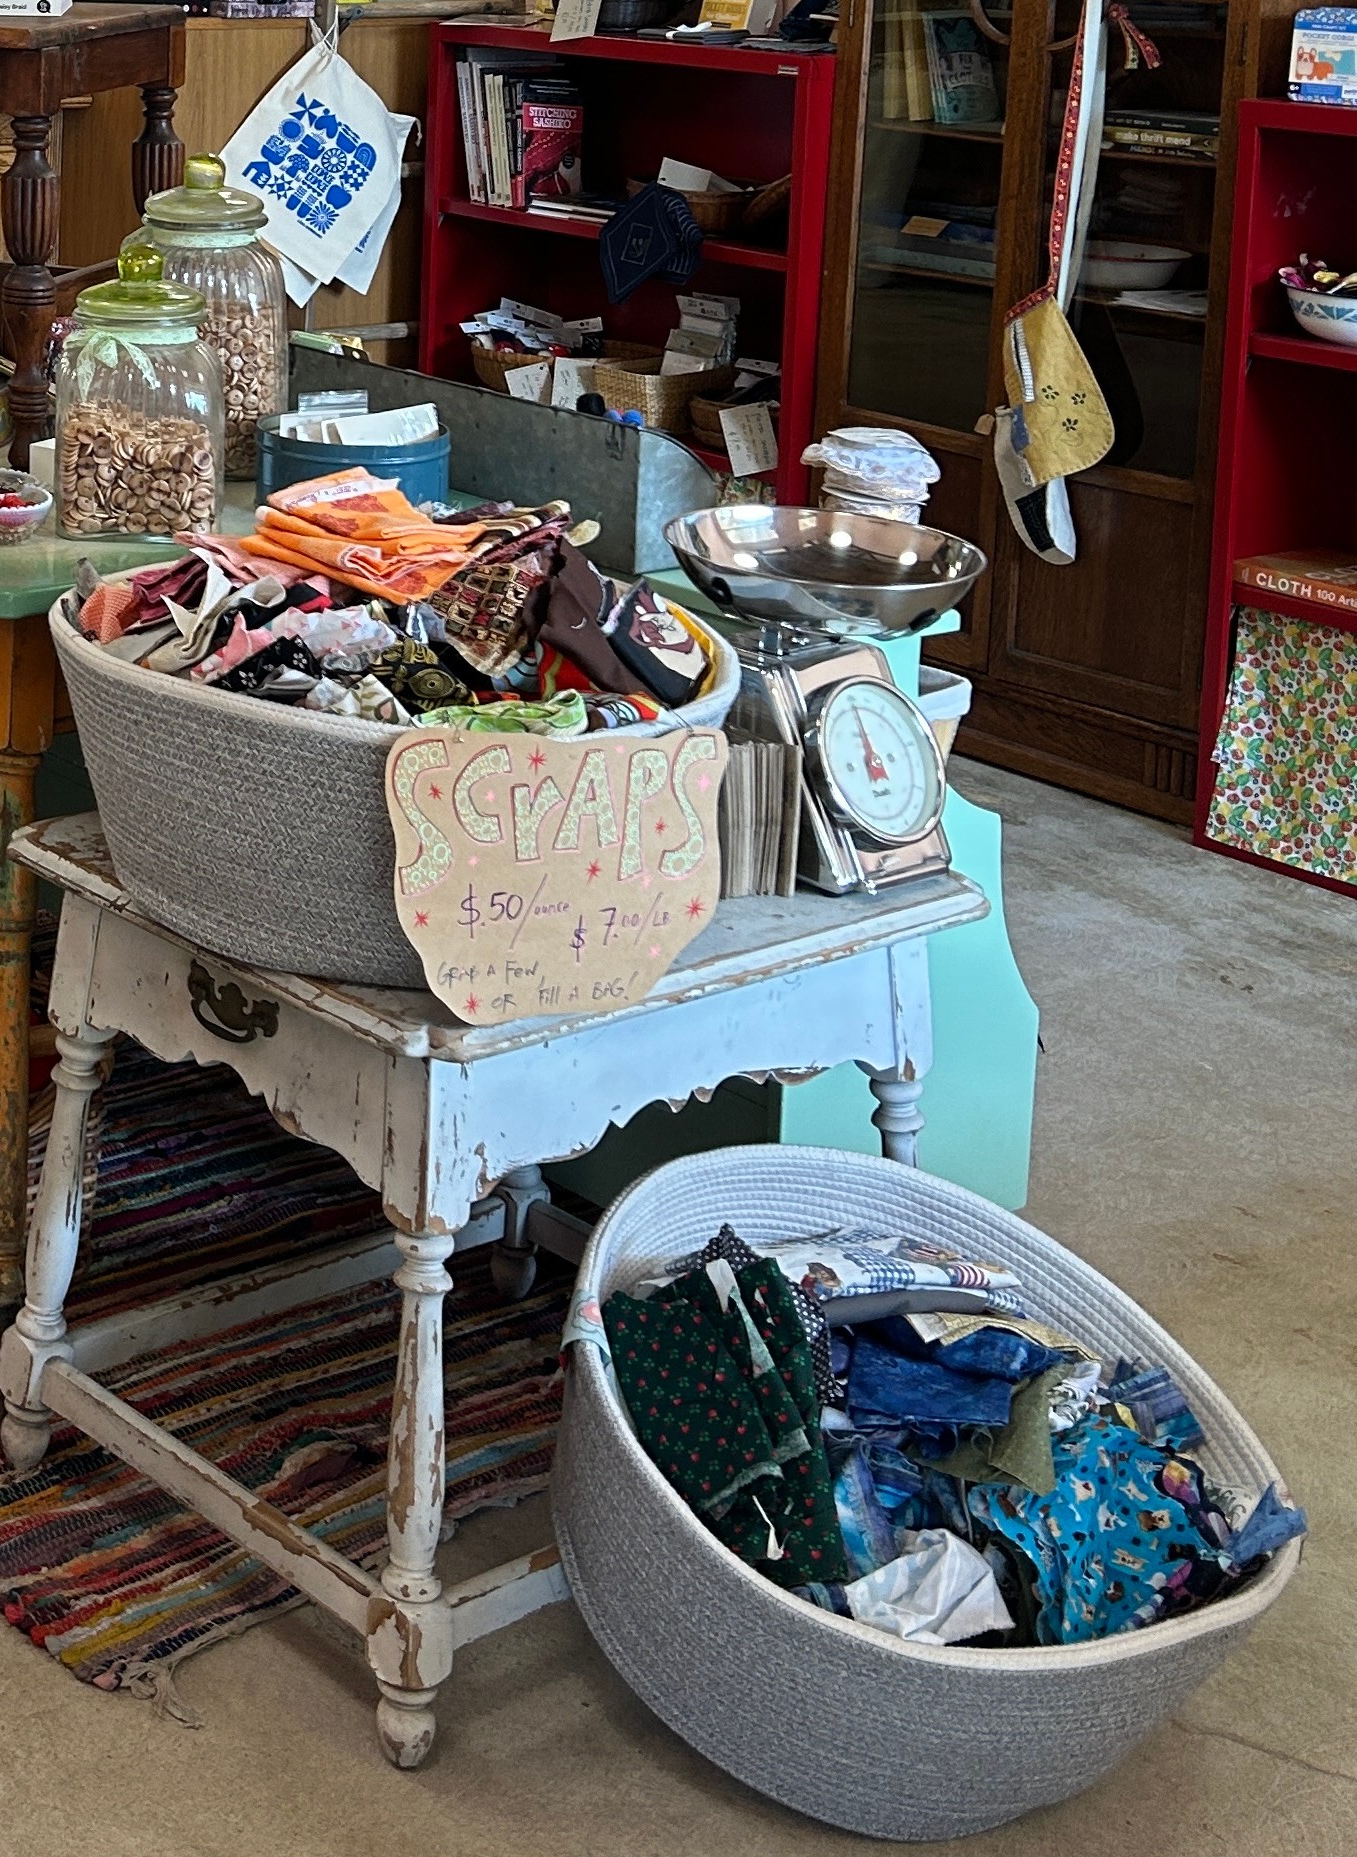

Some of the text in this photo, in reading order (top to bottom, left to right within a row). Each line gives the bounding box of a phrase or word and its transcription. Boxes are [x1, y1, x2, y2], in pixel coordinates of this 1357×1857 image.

[1140, 132, 1164, 143] thrift
[1165, 135, 1192, 146] mend
[1255, 572, 1312, 598] CLOTH
[1316, 588, 1336, 602] 100
[486, 964, 497, 978] A
[568, 986, 580, 1000] A
